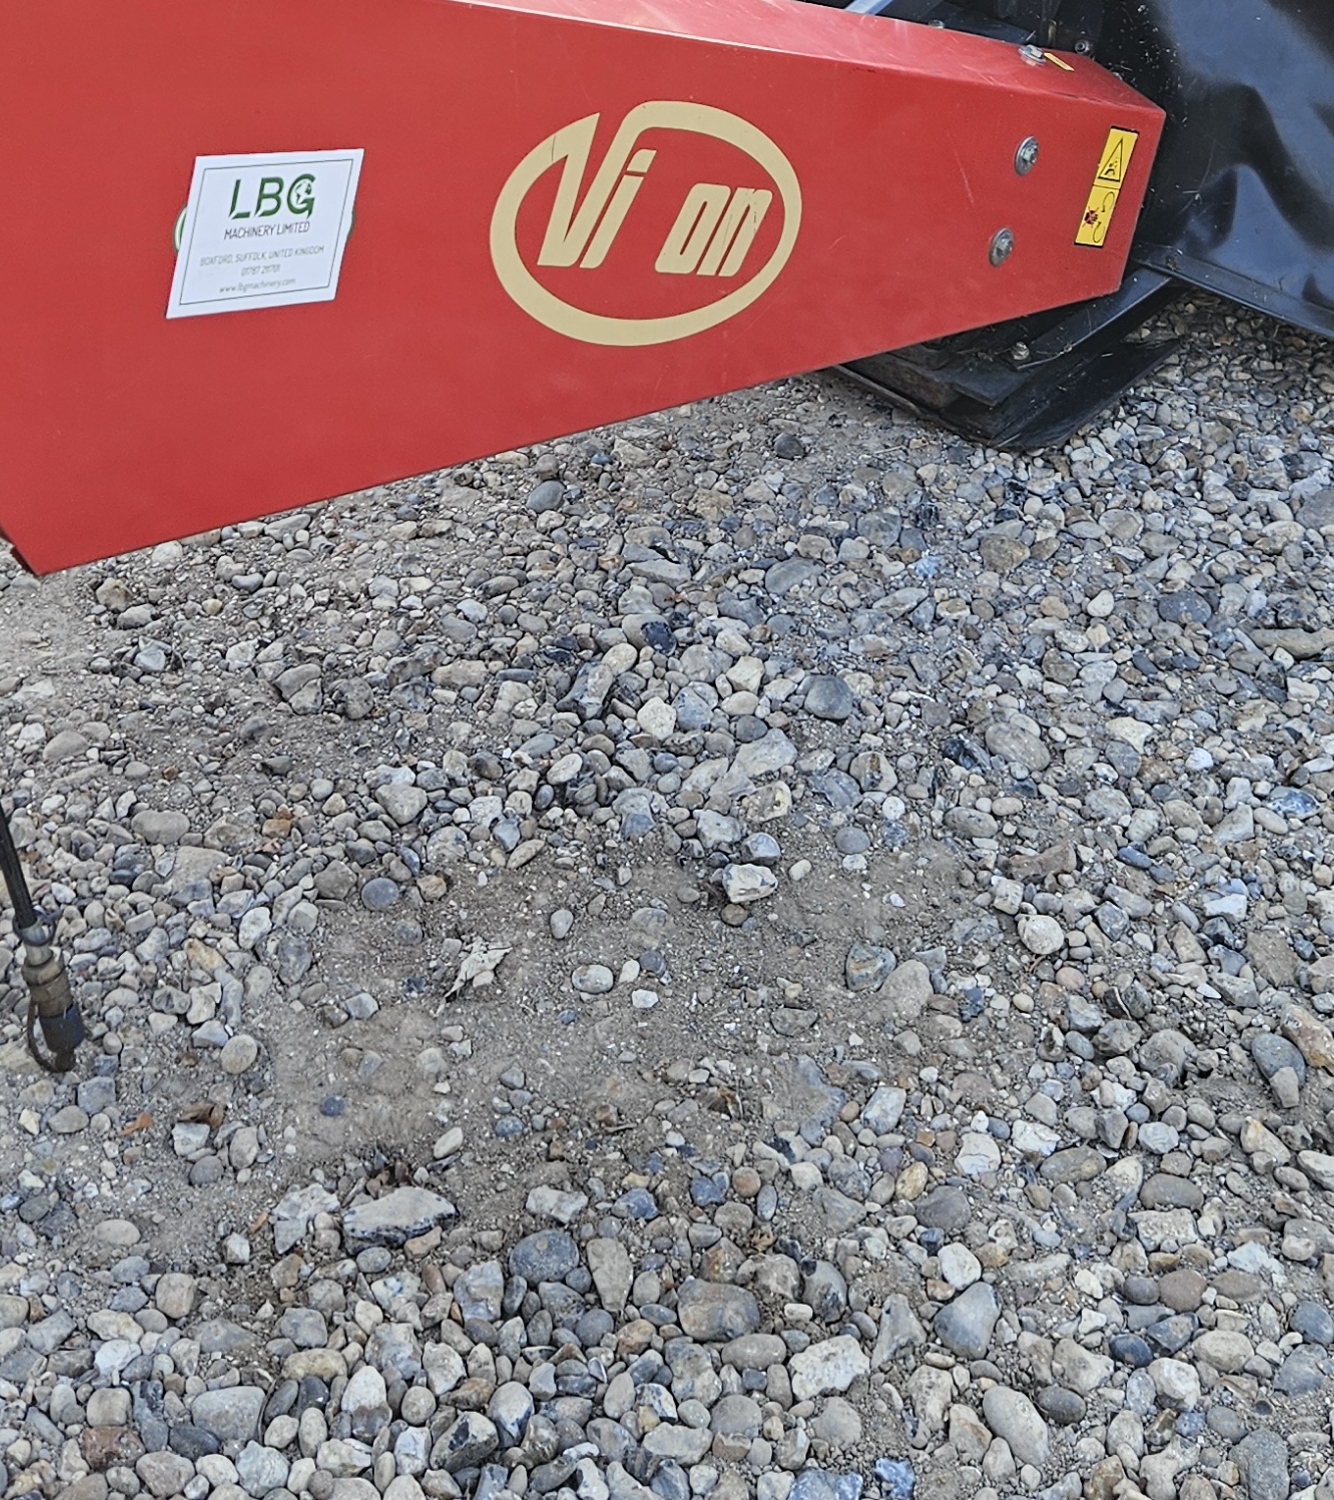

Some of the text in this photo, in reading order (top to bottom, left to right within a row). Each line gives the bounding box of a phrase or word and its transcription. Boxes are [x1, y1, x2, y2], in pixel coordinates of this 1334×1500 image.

[228, 173, 316, 220] LBG
[535, 101, 773, 279] Vion
[223, 220, 310, 240] MACHINERY LIMITED
[269, 248, 293, 259] UNITED
[295, 245, 325, 257] KINGDOM
